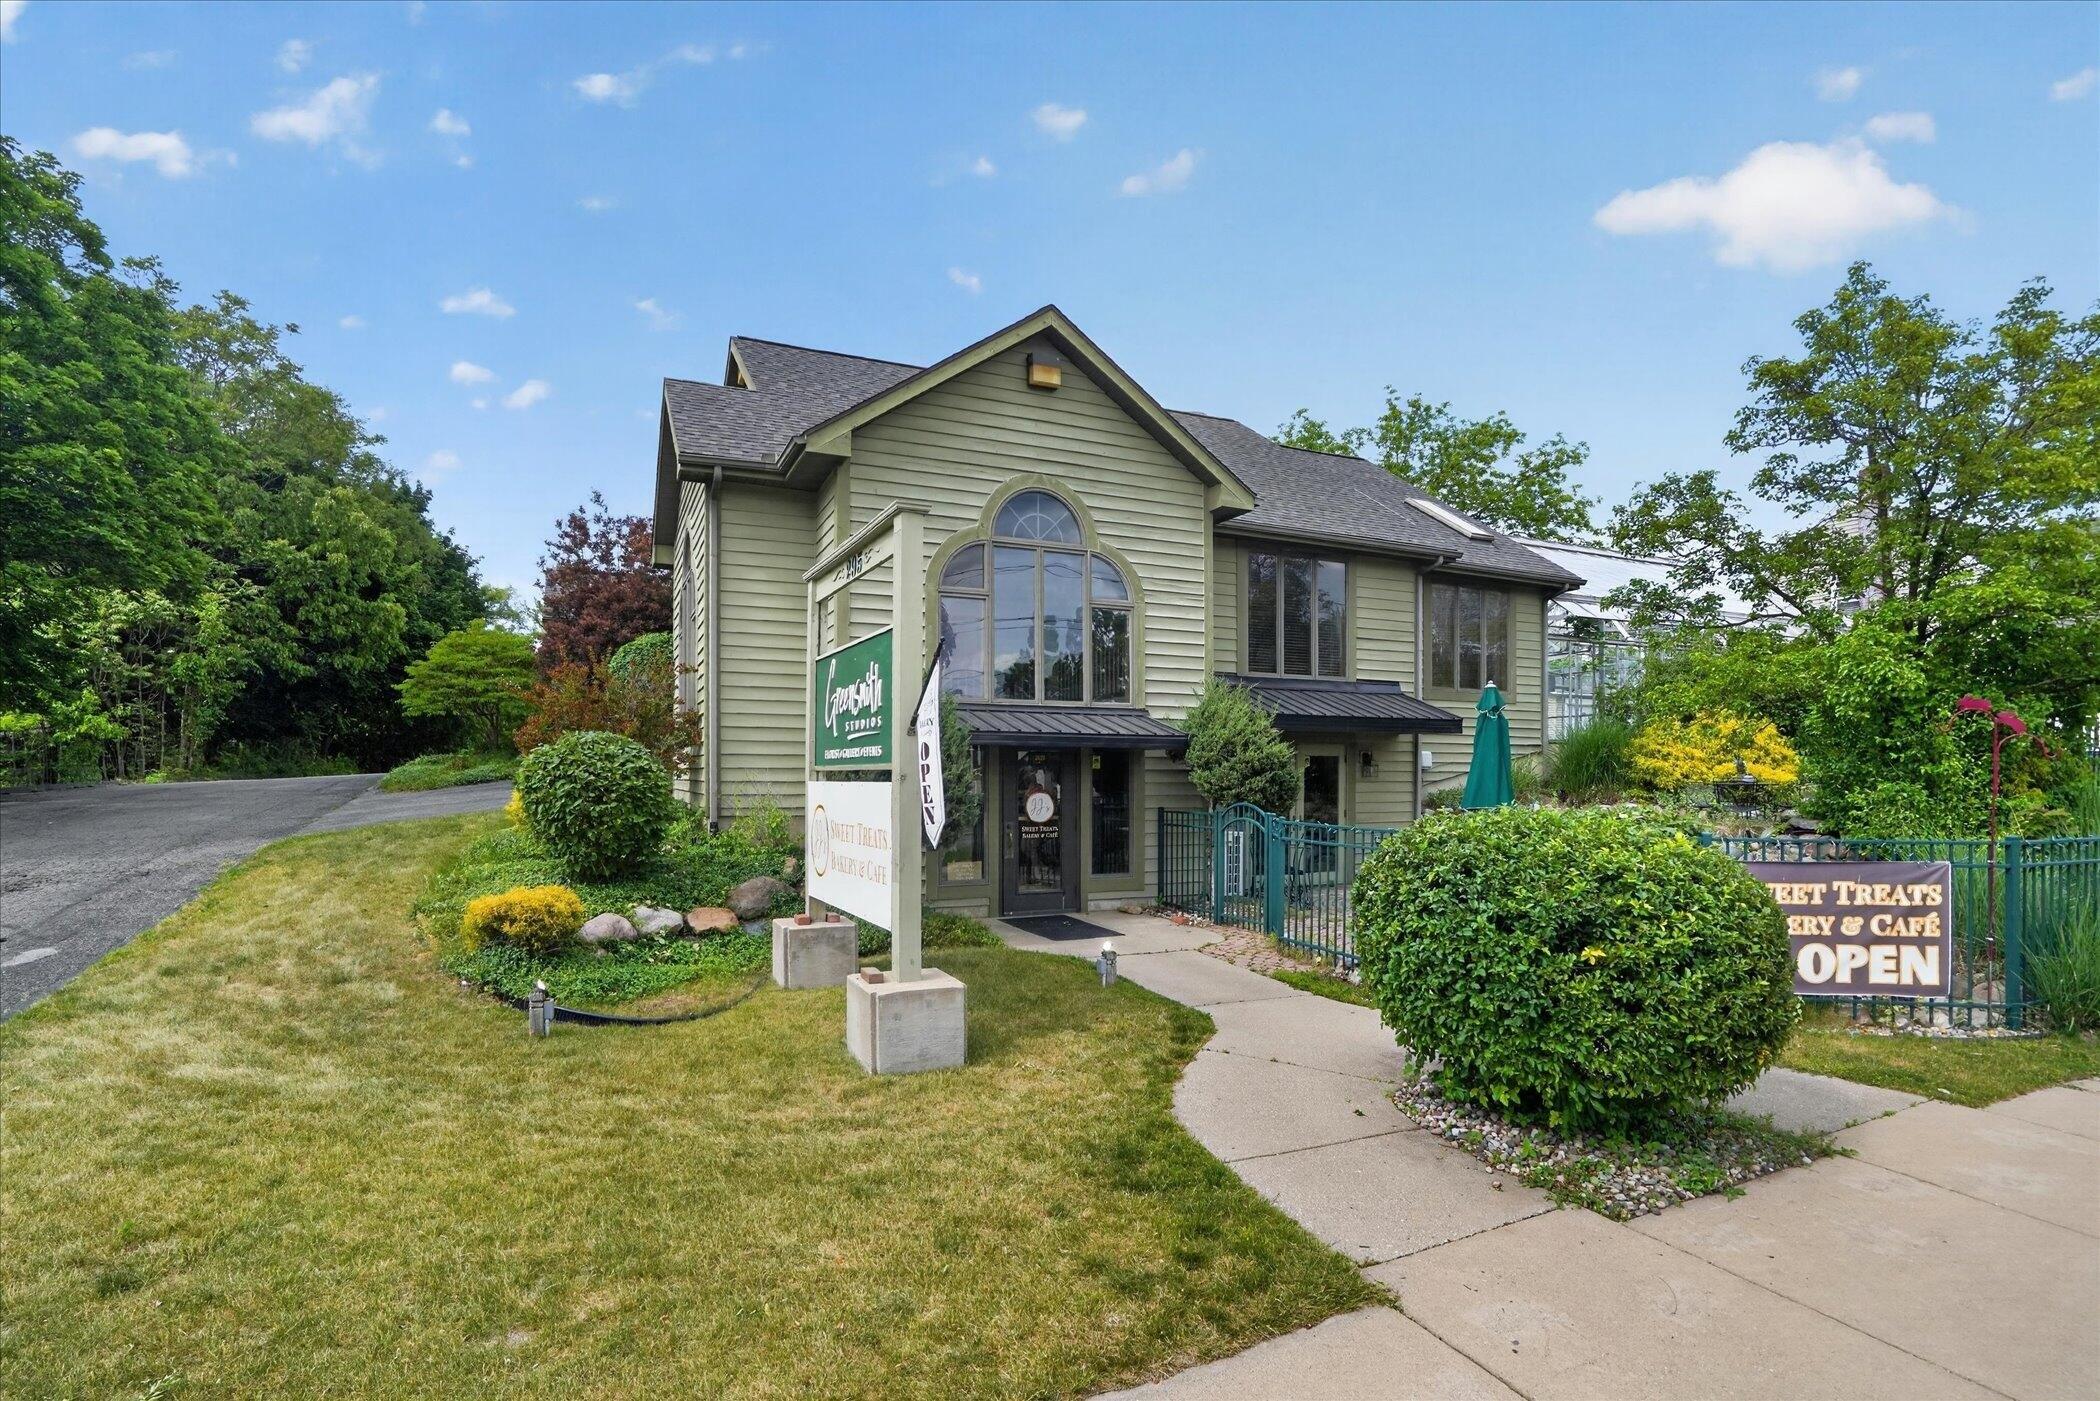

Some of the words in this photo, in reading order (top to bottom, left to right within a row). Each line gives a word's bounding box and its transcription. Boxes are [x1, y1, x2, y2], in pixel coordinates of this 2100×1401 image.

[846, 551, 863, 579] 295
[825, 658, 882, 737] Greensmith
[845, 716, 882, 732] STUDIOS
[920, 742, 935, 825] OPEN
[830, 820, 854, 844] SWEET
[857, 823, 888, 850] TREATS
[1766, 882, 1827, 905] EET
[1832, 881, 1943, 906] TREATS
[1787, 915, 1835, 936] ERY
[1840, 916, 1865, 937] &
[1870, 911, 1941, 938] CAFÉ
[1797, 942, 1940, 986] OPEN
